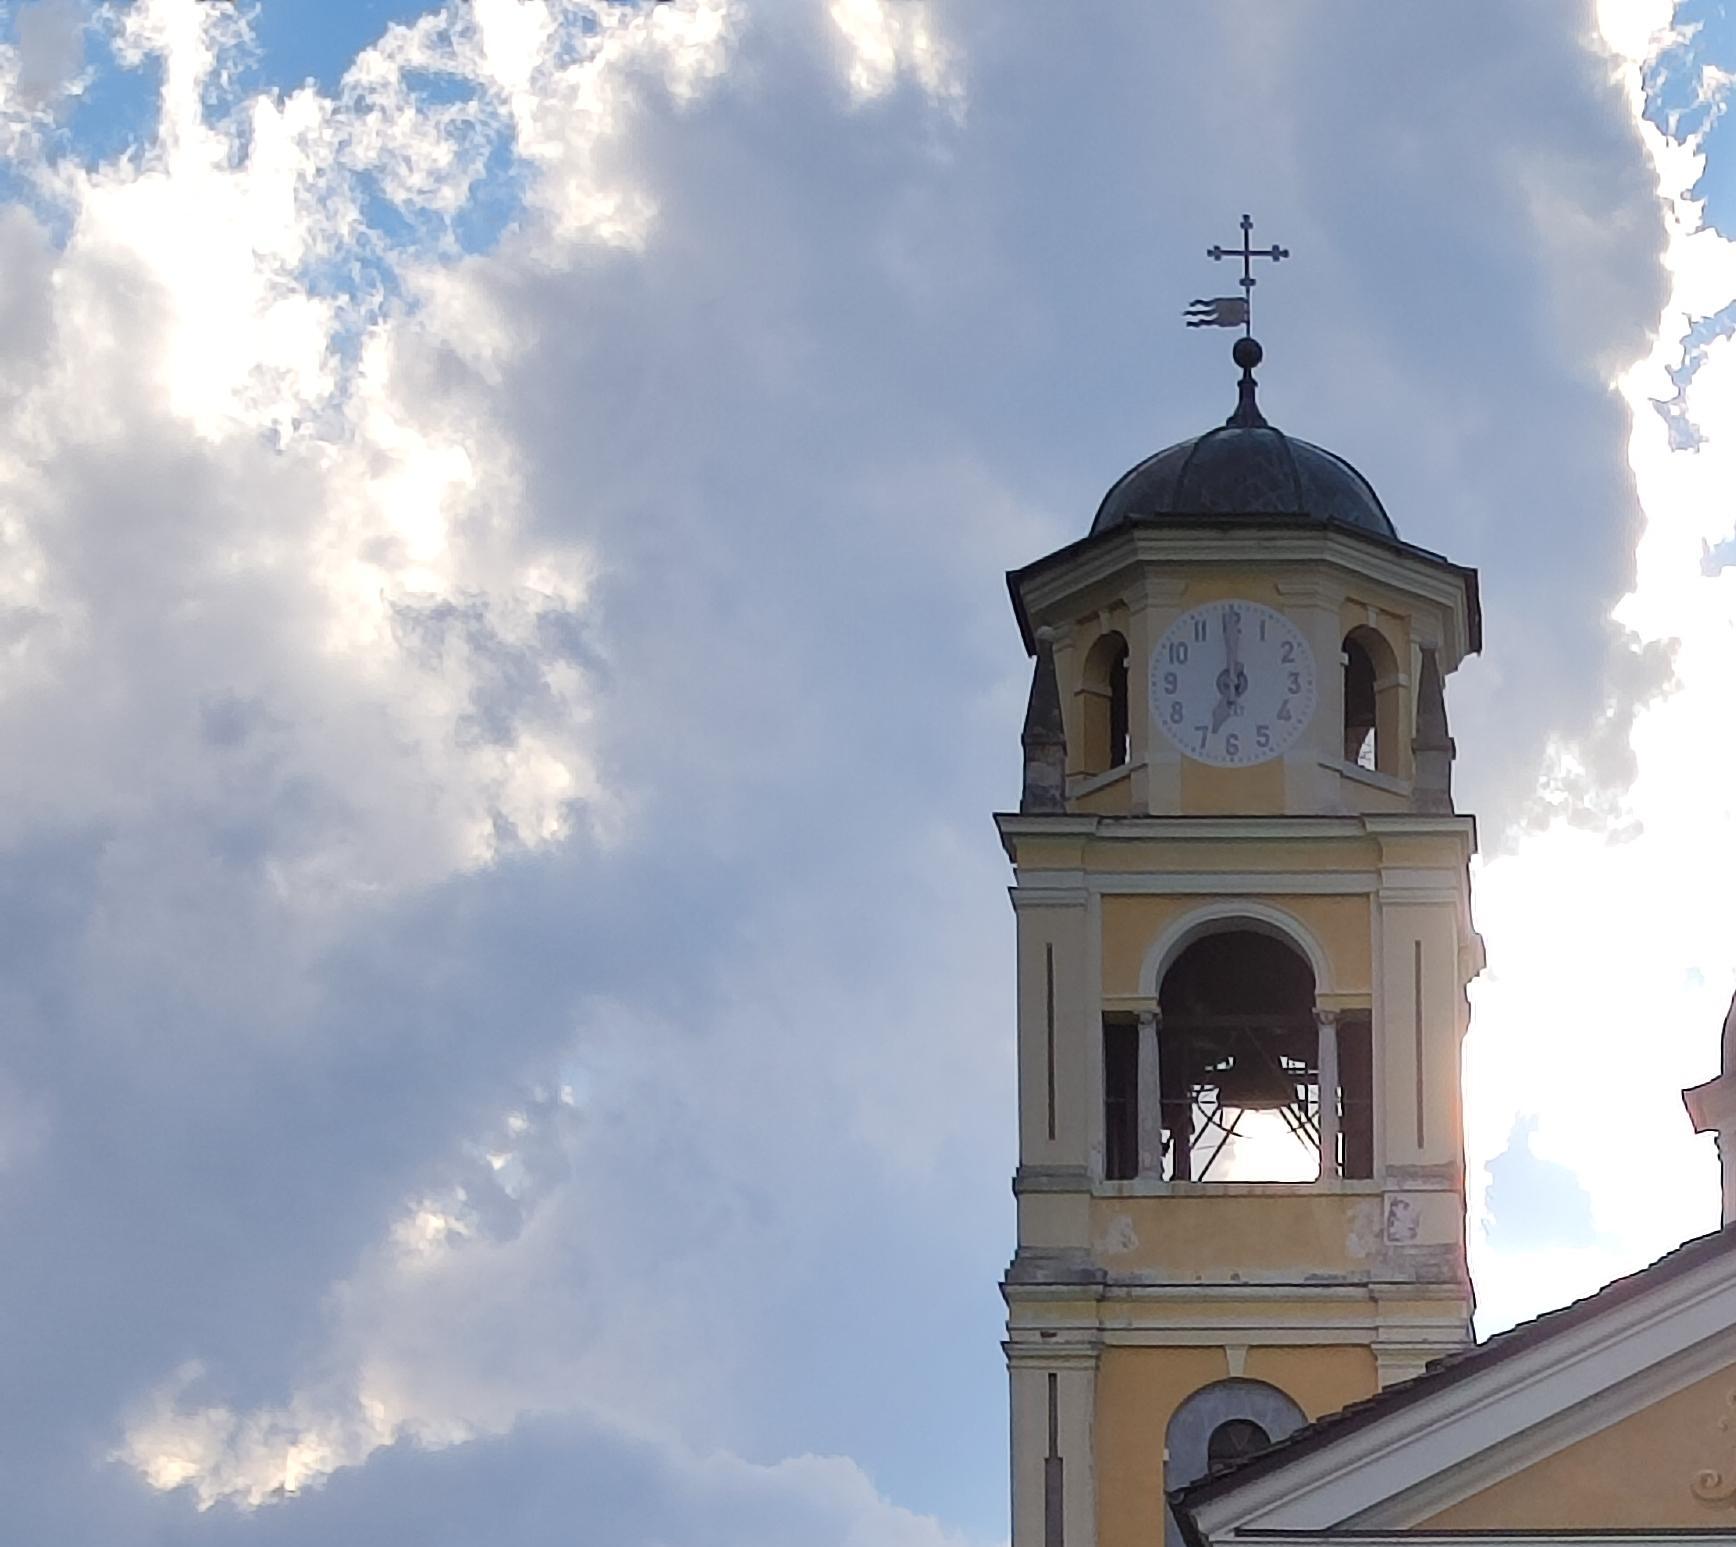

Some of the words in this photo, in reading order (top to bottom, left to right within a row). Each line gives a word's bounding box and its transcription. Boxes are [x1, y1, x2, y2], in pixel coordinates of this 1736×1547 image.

[1193, 619, 1207, 642] 11
[1259, 619, 1266, 642] 1
[1168, 642, 1189, 665] 10
[1280, 641, 1295, 664] 2
[1163, 672, 1178, 695] 9
[1286, 672, 1302, 695] 3
[1169, 701, 1184, 724] 8
[1276, 699, 1292, 722] 4
[1193, 726, 1209, 750] 7
[1225, 733, 1239, 757] 6
[1255, 725, 1270, 748] 5
